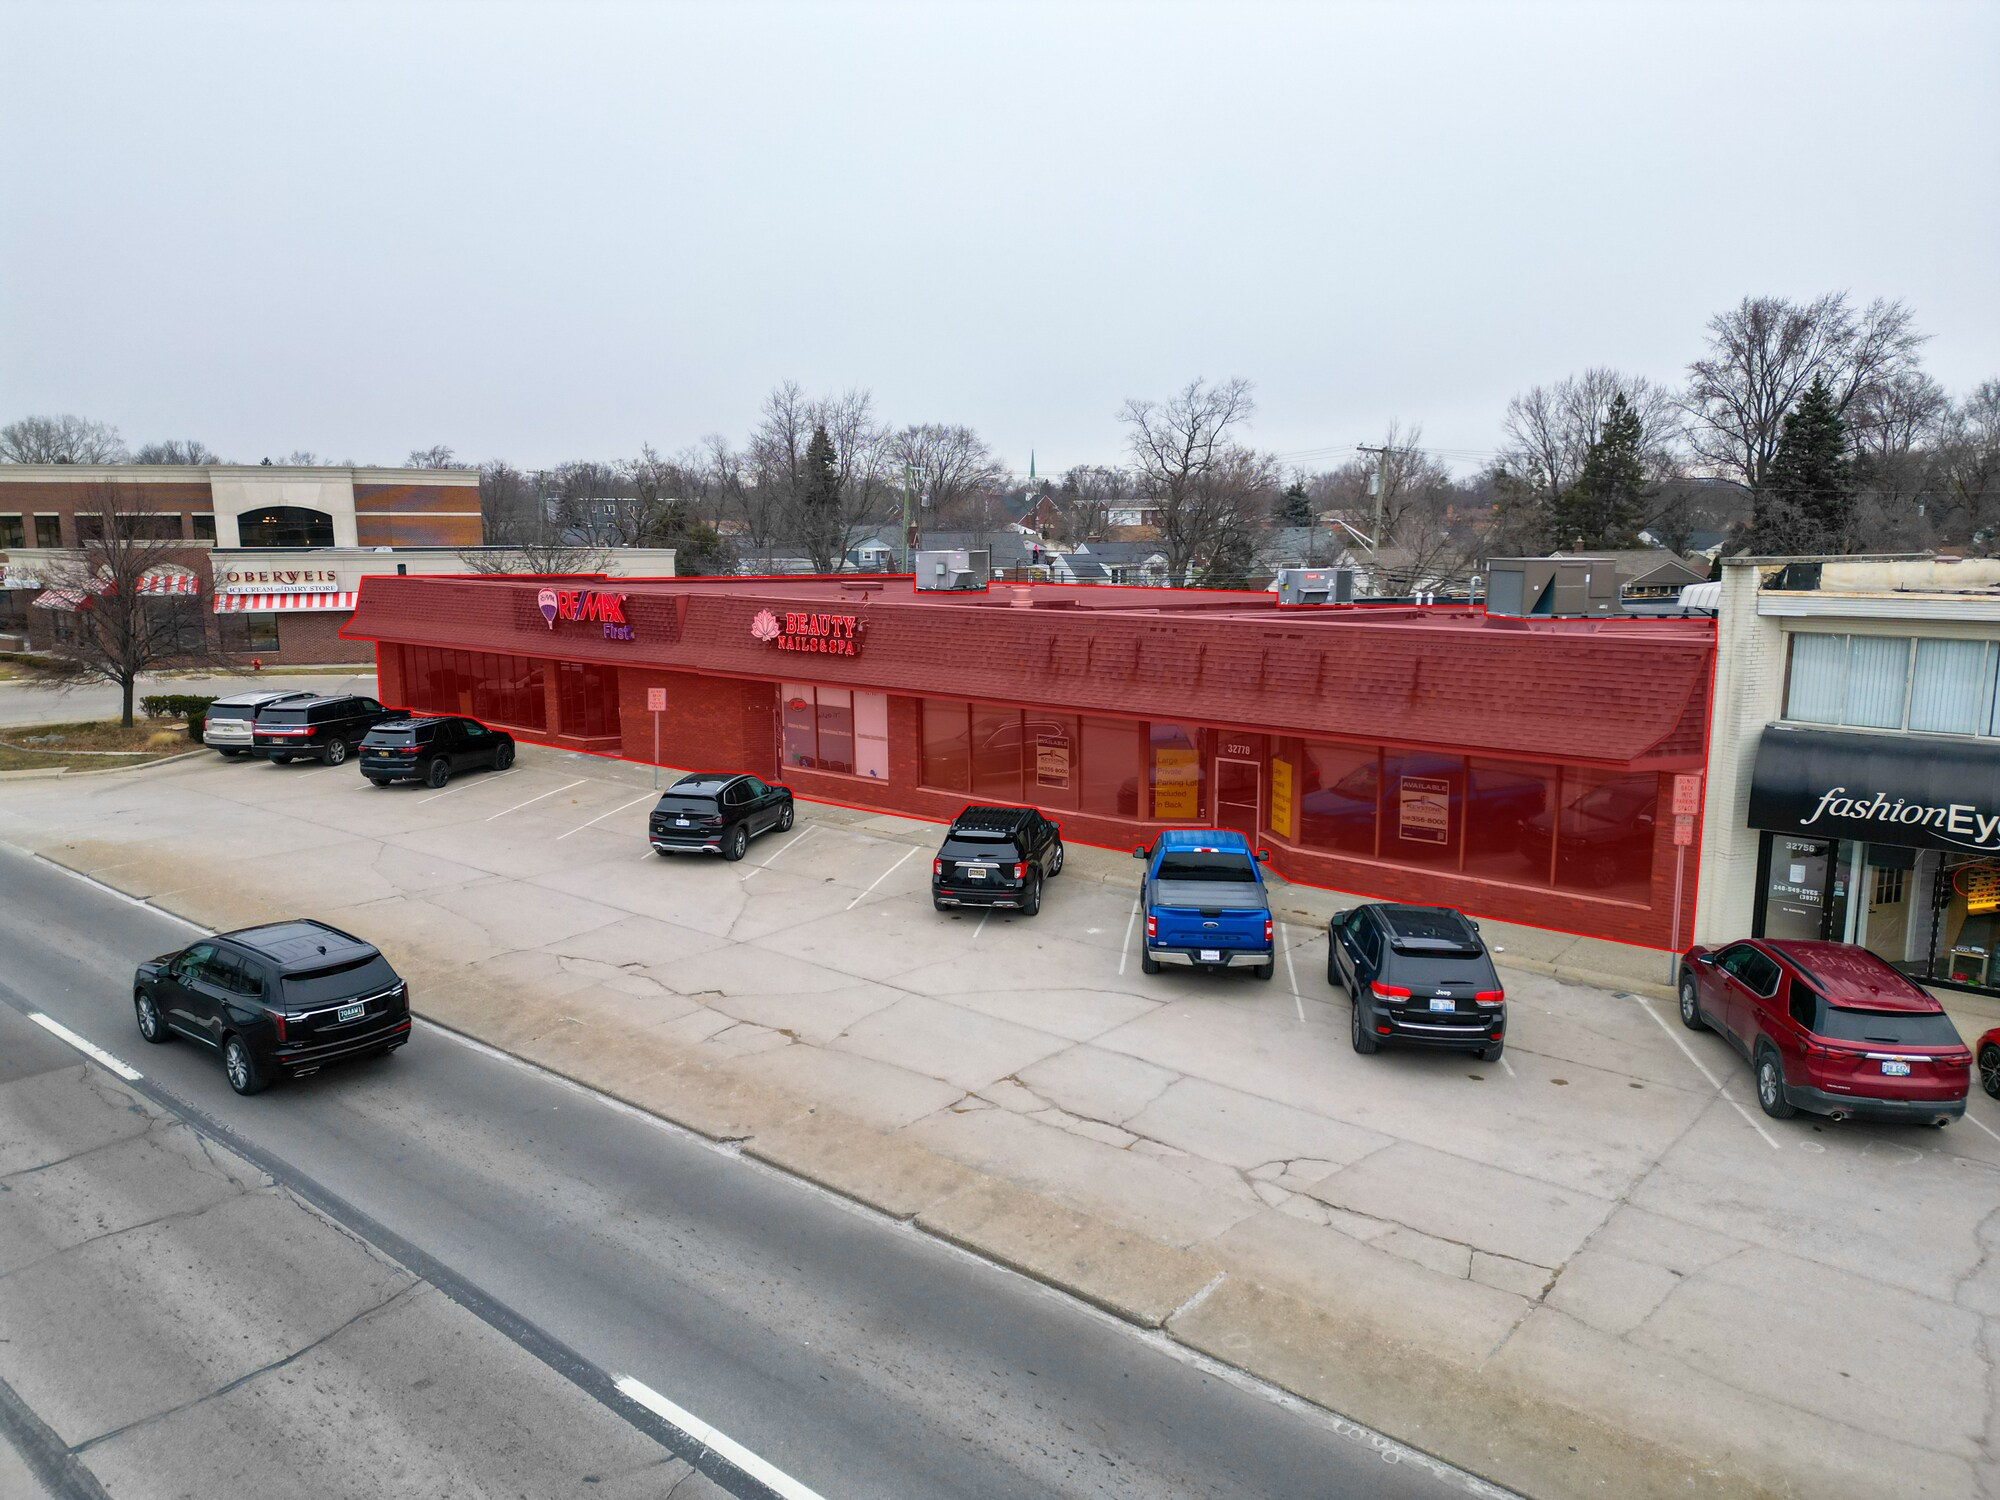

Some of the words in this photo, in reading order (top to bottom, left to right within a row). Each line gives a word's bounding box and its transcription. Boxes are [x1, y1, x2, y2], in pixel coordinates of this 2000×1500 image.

[226, 570, 336, 585] OBERWEIS
[557, 590, 626, 623] RE/MAX
[786, 613, 856, 638] BEAUTY
[1227, 744, 1250, 755] 32778
[1157, 757, 1178, 765] Large
[1157, 779, 1184, 787] Parking
[1186, 779, 1198, 787] Lot
[1403, 782, 1447, 791] AVAILABLE
[1785, 842, 1815, 853] 32756
